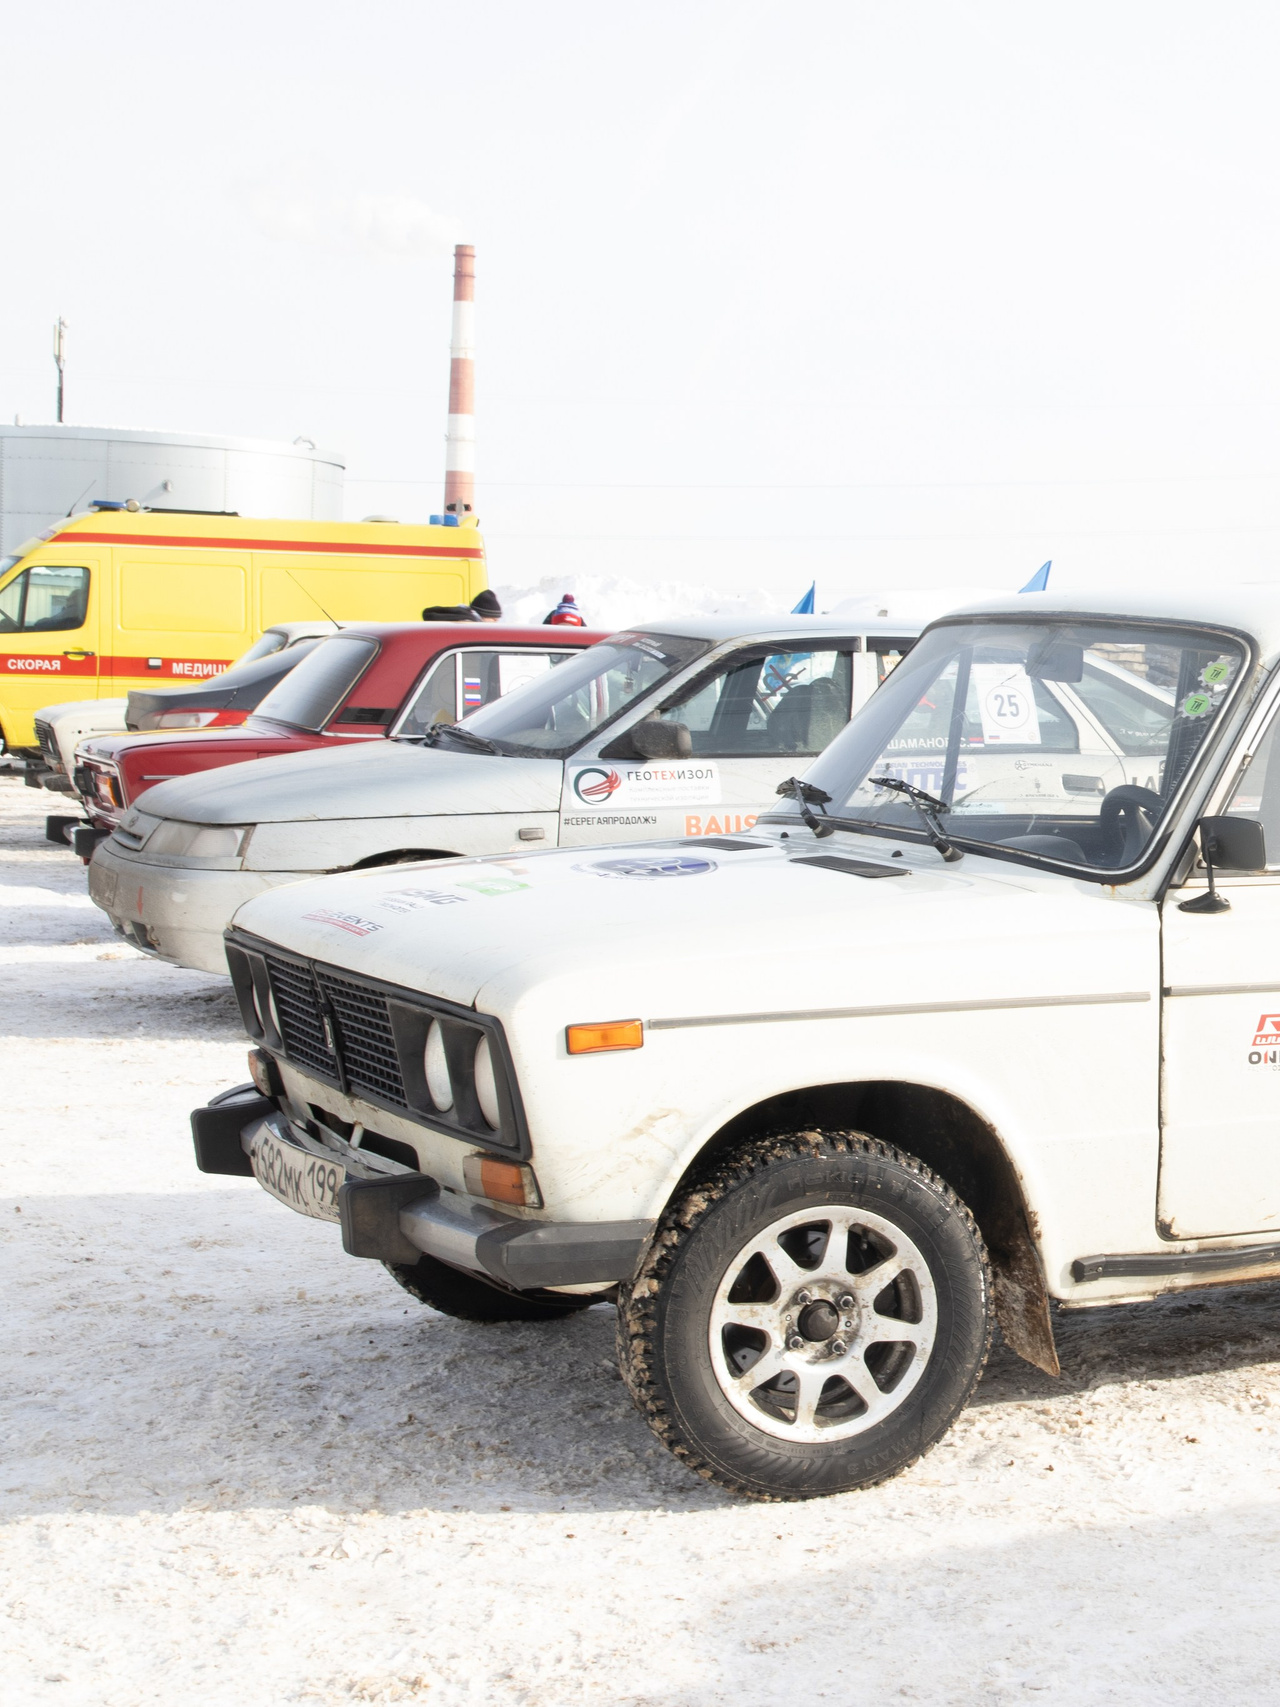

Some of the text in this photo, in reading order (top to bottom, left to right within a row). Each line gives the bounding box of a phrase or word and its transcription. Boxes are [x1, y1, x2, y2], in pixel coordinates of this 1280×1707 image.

[7, 658, 61, 671] СКОРАЯ
[993, 694, 1020, 717] 25
[887, 737, 949, 750] ШАМАНО
[626, 769, 714, 781] ГЕОТЕХИЗОЛ
[563, 815, 657, 827] #СЕРЕГАЯПРОДОЛЖУ
[307, 1161, 337, 1206] 199
